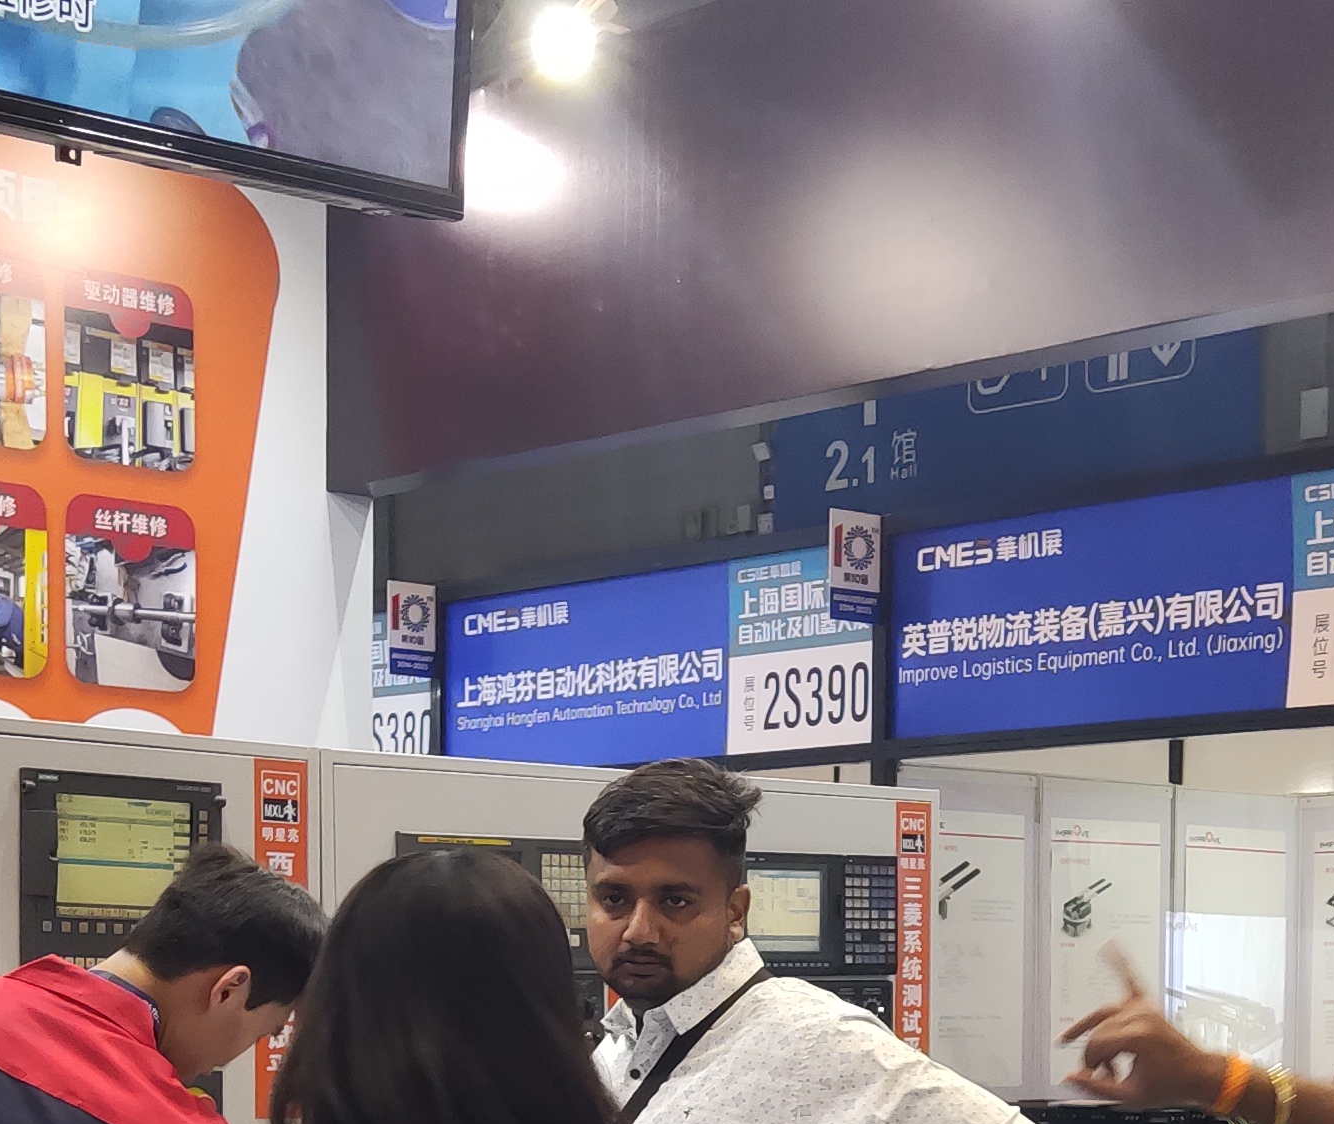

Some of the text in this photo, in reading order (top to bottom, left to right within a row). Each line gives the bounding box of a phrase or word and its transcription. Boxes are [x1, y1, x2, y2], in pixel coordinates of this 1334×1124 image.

[83, 278, 175, 316] 驱动器维修
[824, 428, 917, 492] 2.1 馆
[890, 465, 917, 480] Hall
[95, 509, 167, 538] 丝杆维修
[917, 539, 993, 572] CMES
[738, 578, 830, 619] 上海国际
[464, 609, 519, 636] CMES
[739, 611, 870, 645] 自动化及机器
[901, 582, 1285, 658] 英普锐物流装备(嘉兴)有限公司
[898, 626, 1284, 687] Improve Logistics Equipment Co., Ltd. (Jiaxing)
[1312, 614, 1330, 679] 展位号
[456, 648, 723, 708] 上海鸿芬自动化科技有限公司
[764, 662, 869, 730] 2S390
[457, 713, 504, 732] Shanghai
[552, 702, 613, 722] Automation
[615, 696, 676, 715] Technology
[262, 778, 298, 797] CNC
[262, 827, 299, 843] 明星亮
[901, 817, 925, 832] CNC
